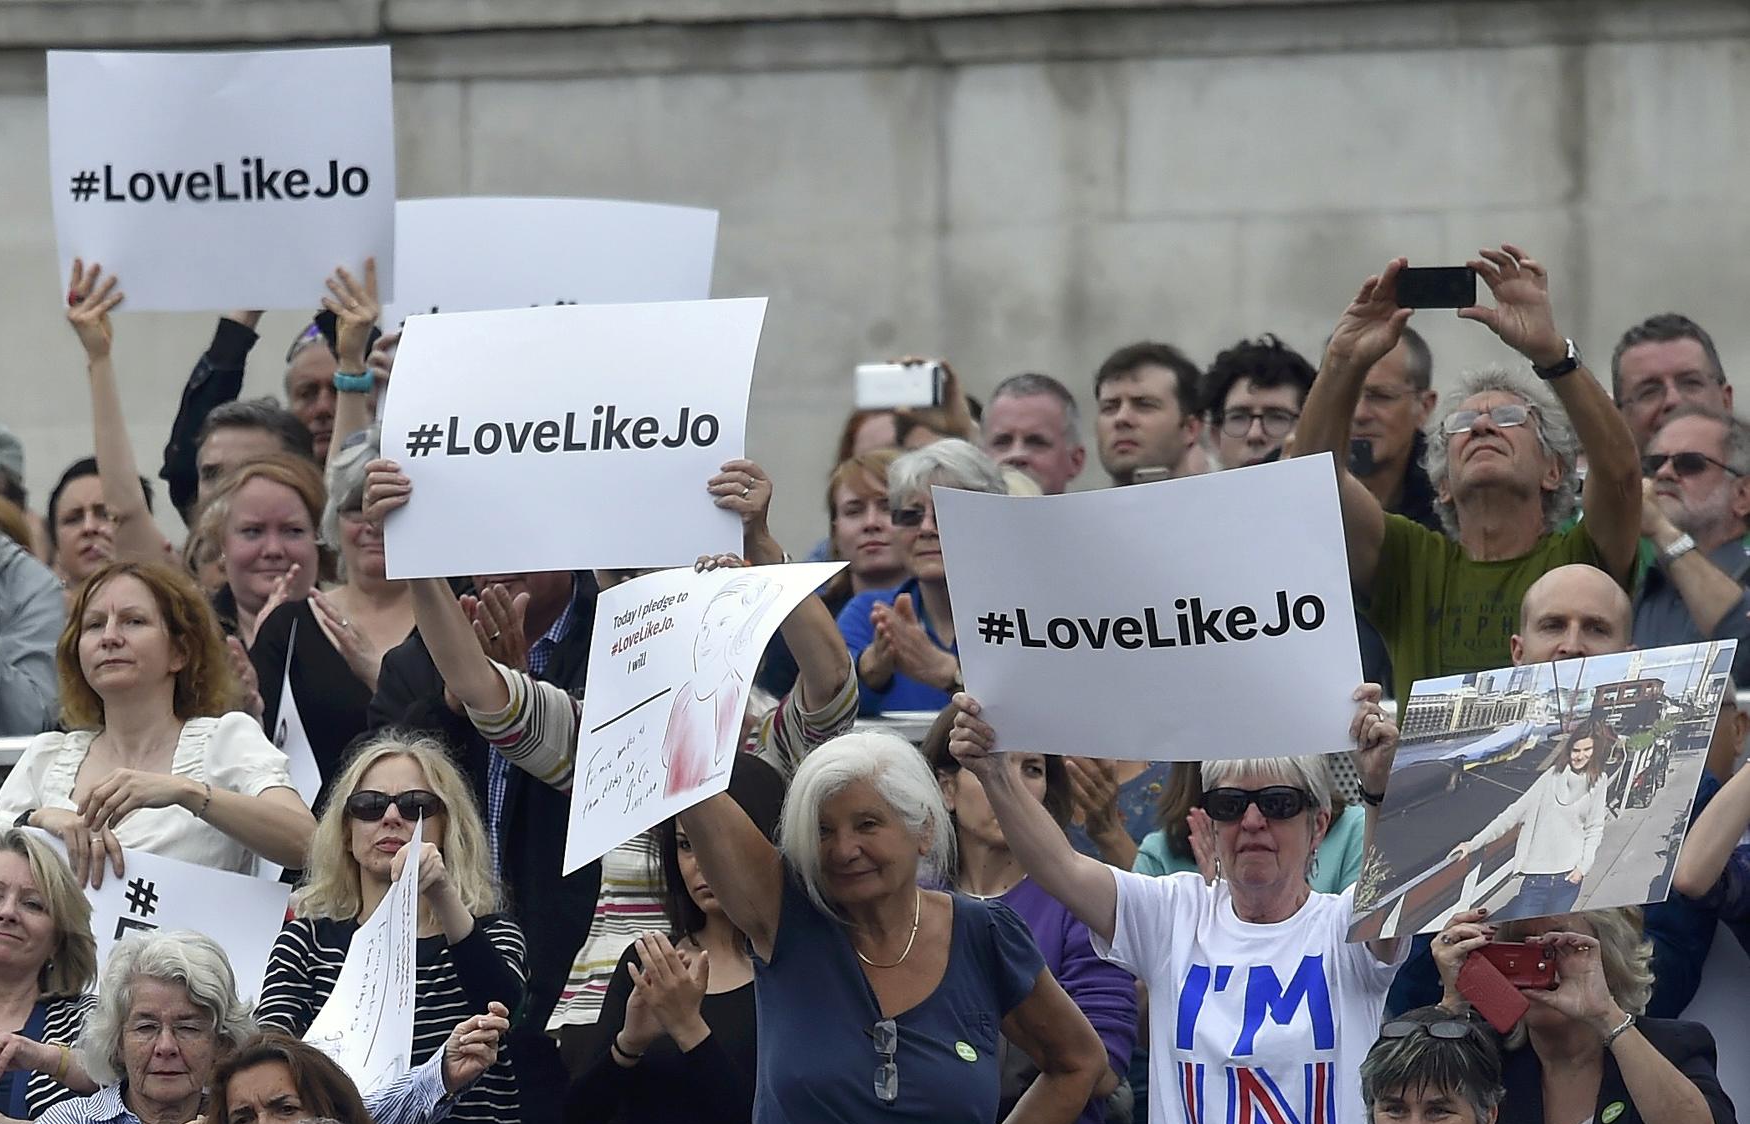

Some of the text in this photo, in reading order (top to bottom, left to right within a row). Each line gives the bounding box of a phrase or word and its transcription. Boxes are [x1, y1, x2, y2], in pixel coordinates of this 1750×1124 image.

[70, 157, 371, 204] #LoveLikeJo
[406, 405, 720, 458] #LoveLikeJo
[613, 609, 637, 630] Today
[642, 595, 676, 620] pledge
[676, 592, 689, 604] to
[978, 590, 1327, 650] #LoveLikeJo
[610, 616, 675, 657] #LoveLikeJo.
[632, 651, 647, 672] will
[1176, 952, 1335, 1057] I'M
